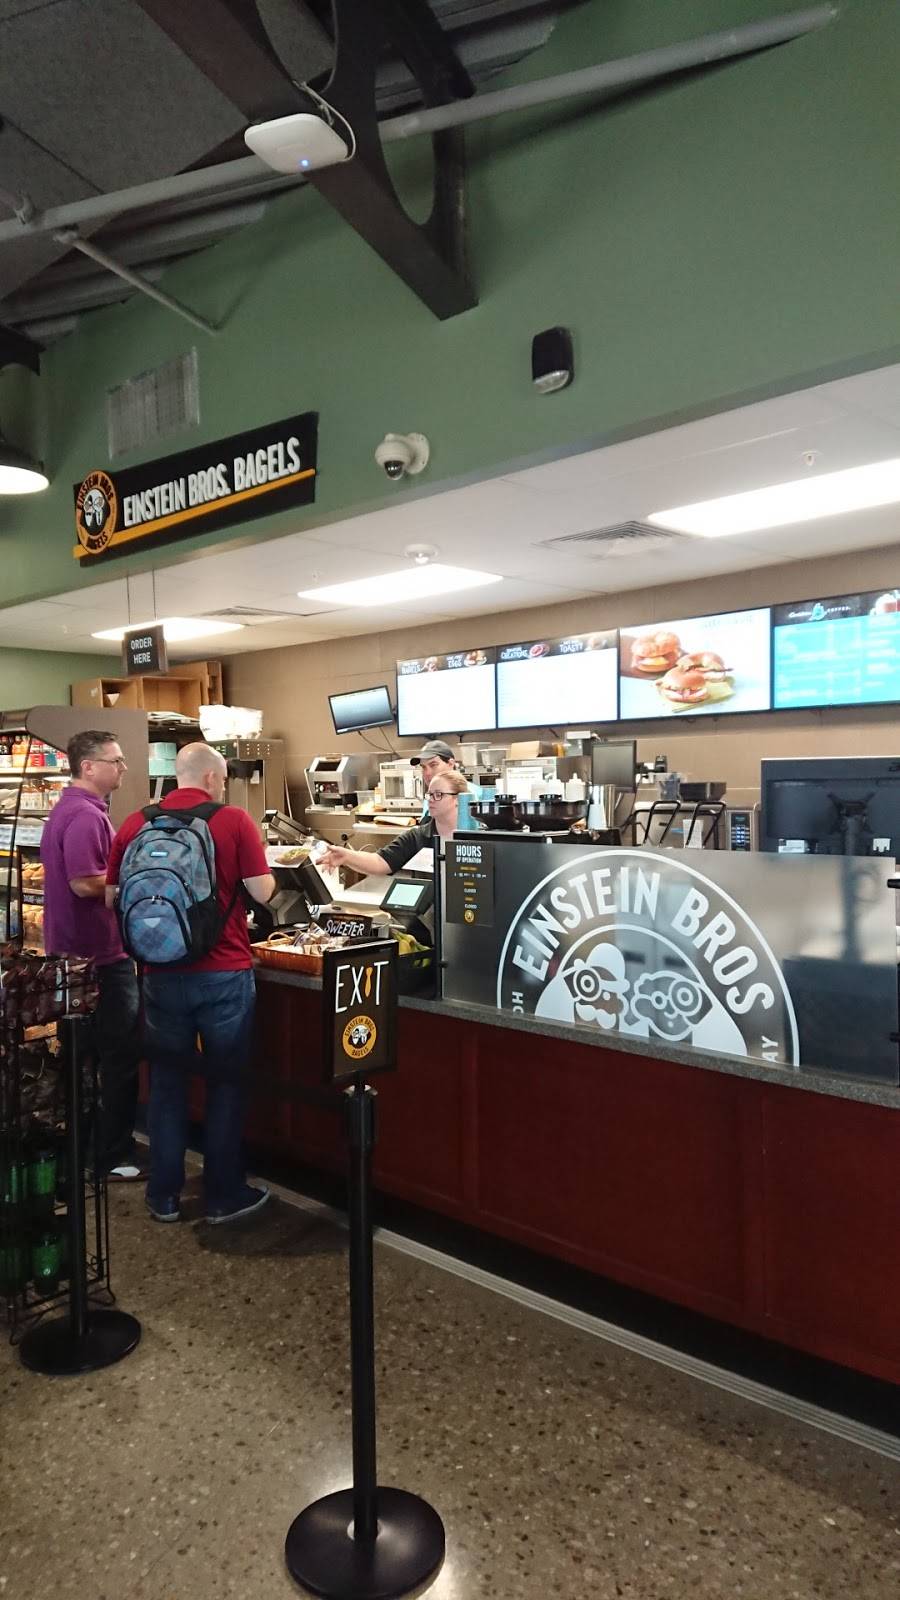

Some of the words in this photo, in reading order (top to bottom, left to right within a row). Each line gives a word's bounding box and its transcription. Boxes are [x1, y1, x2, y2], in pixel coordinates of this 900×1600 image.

[123, 477, 187, 527] EINSTEIN
[188, 462, 231, 507] BROS.
[234, 436, 301, 490] BAGELS
[130, 636, 153, 650] ORDER
[133, 652, 152, 665] HERE
[455, 845, 482, 857] HOURS
[324, 919, 365, 937] SWEETER
[512, 866, 661, 982] EINSTEIN
[670, 886, 776, 1016] BROS
[335, 960, 390, 1014] EXIT
